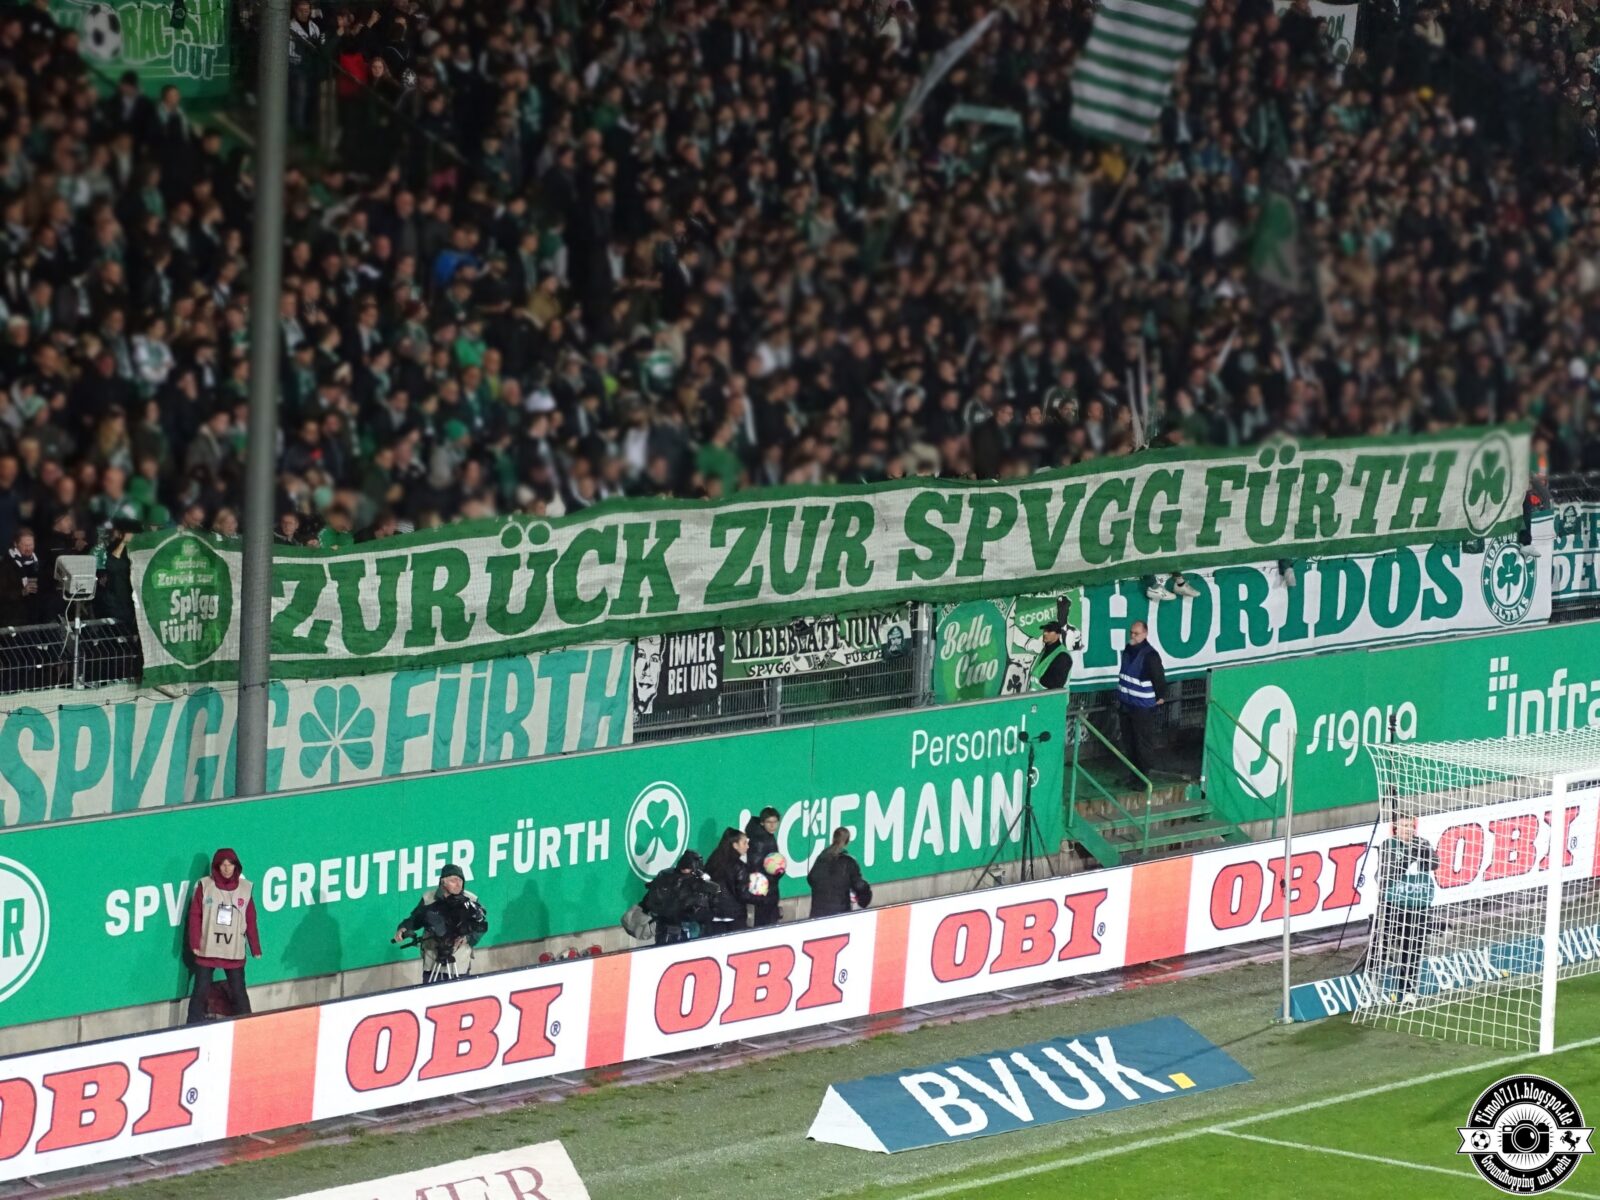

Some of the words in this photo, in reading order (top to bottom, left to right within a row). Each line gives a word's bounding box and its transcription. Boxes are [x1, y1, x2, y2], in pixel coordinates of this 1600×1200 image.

[119, 0, 224, 64] RACSM
[173, 41, 218, 79] OUT
[270, 519, 681, 655] ZURÜCK
[704, 501, 875, 604] ZUR
[897, 468, 1184, 581] SPVGG
[1196, 445, 1459, 547] FÜRTH
[160, 616, 202, 644] Fürth
[170, 588, 219, 621] SpVgg
[1083, 543, 1464, 668] HORIDOS
[669, 632, 715, 667] IMMER
[941, 614, 992, 660] Bella
[668, 667, 687, 695] BEI
[691, 663, 717, 692] UNS
[748, 661, 791, 677] SPVGG
[955, 653, 998, 688] Ciao
[381, 645, 635, 777] FÜRTH
[1306, 700, 1417, 767] signia
[911, 714, 1026, 769] Personal
[263, 839, 475, 913] GREUTHER
[488, 817, 611, 878] FÜRTH
[1210, 842, 1368, 930] OBI
[213, 932, 233, 945] TV
[931, 888, 1108, 983] OBI
[654, 932, 850, 1035] OBI
[346, 983, 564, 1093] OBI
